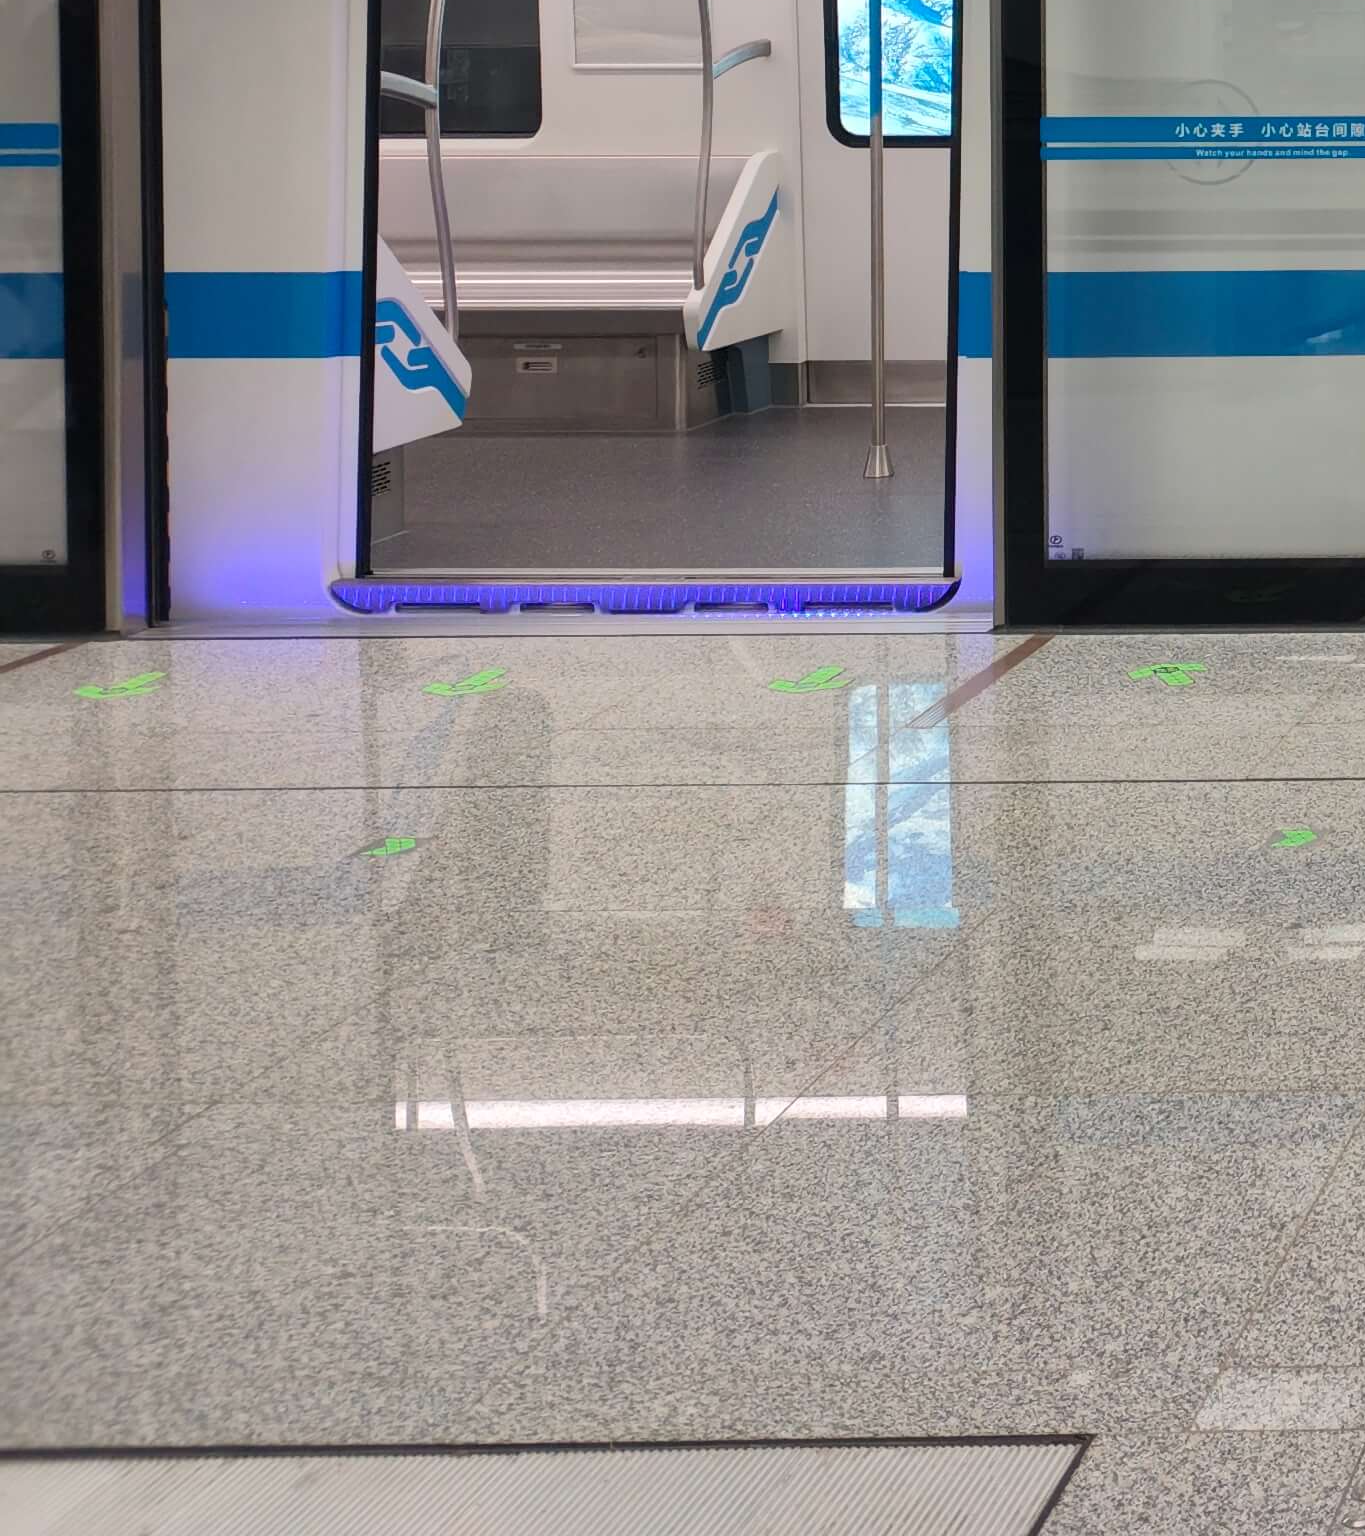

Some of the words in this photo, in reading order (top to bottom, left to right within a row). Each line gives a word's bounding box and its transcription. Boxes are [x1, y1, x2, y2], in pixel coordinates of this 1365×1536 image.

[1175, 122, 1245, 138] 小心夹手
[1260, 122, 1365, 138] 小心站台间隙
[1196, 148, 1223, 157] Watch
[1224, 148, 1244, 157] your
[1246, 148, 1273, 157] hands
[1275, 148, 1291, 157] and
[1293, 148, 1314, 157] mind
[1316, 148, 1330, 157] the
